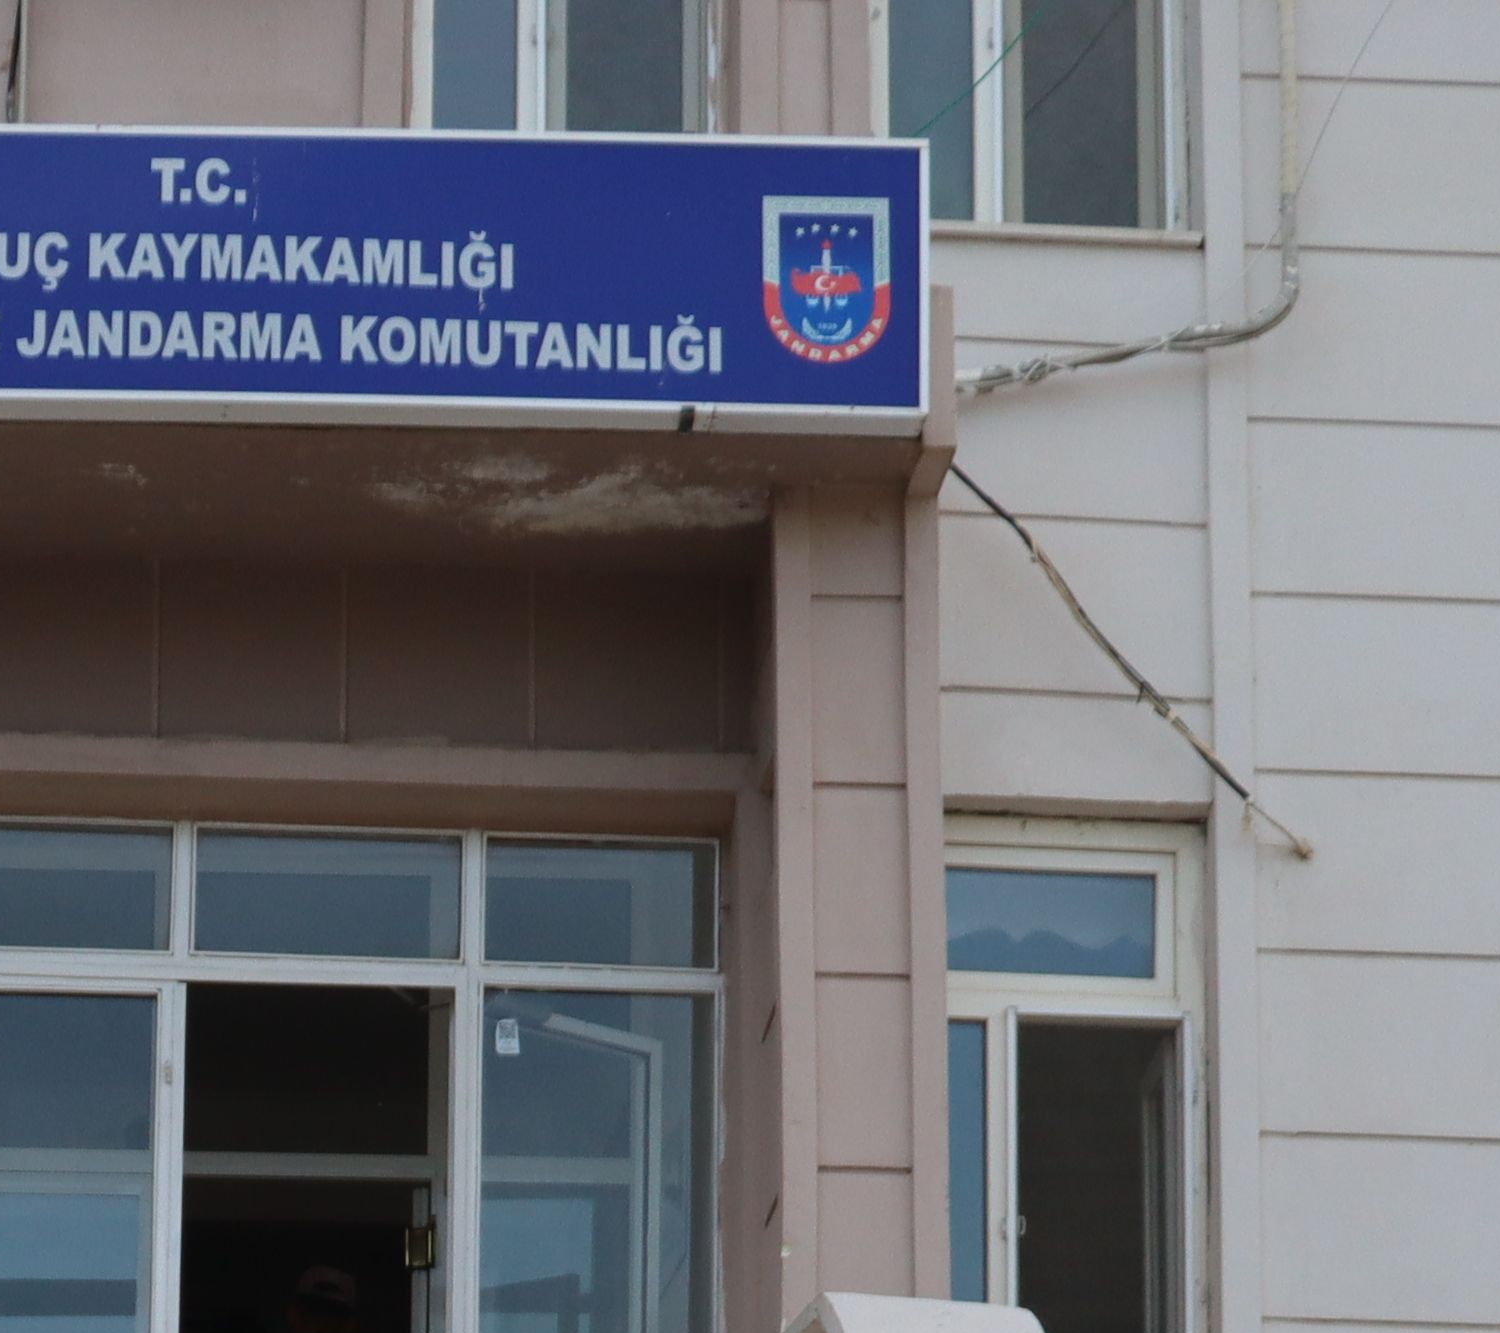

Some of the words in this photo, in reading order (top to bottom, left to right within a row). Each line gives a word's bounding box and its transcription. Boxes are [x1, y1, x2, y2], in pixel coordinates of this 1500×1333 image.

[150, 157, 247, 205] T.C.
[88, 230, 514, 290] KAYMAKAMLIĞI
[16, 309, 322, 361] JANDARMA
[340, 314, 722, 373] KOMUTANLIĞI
[769, 314, 884, 363] JANDARMA
